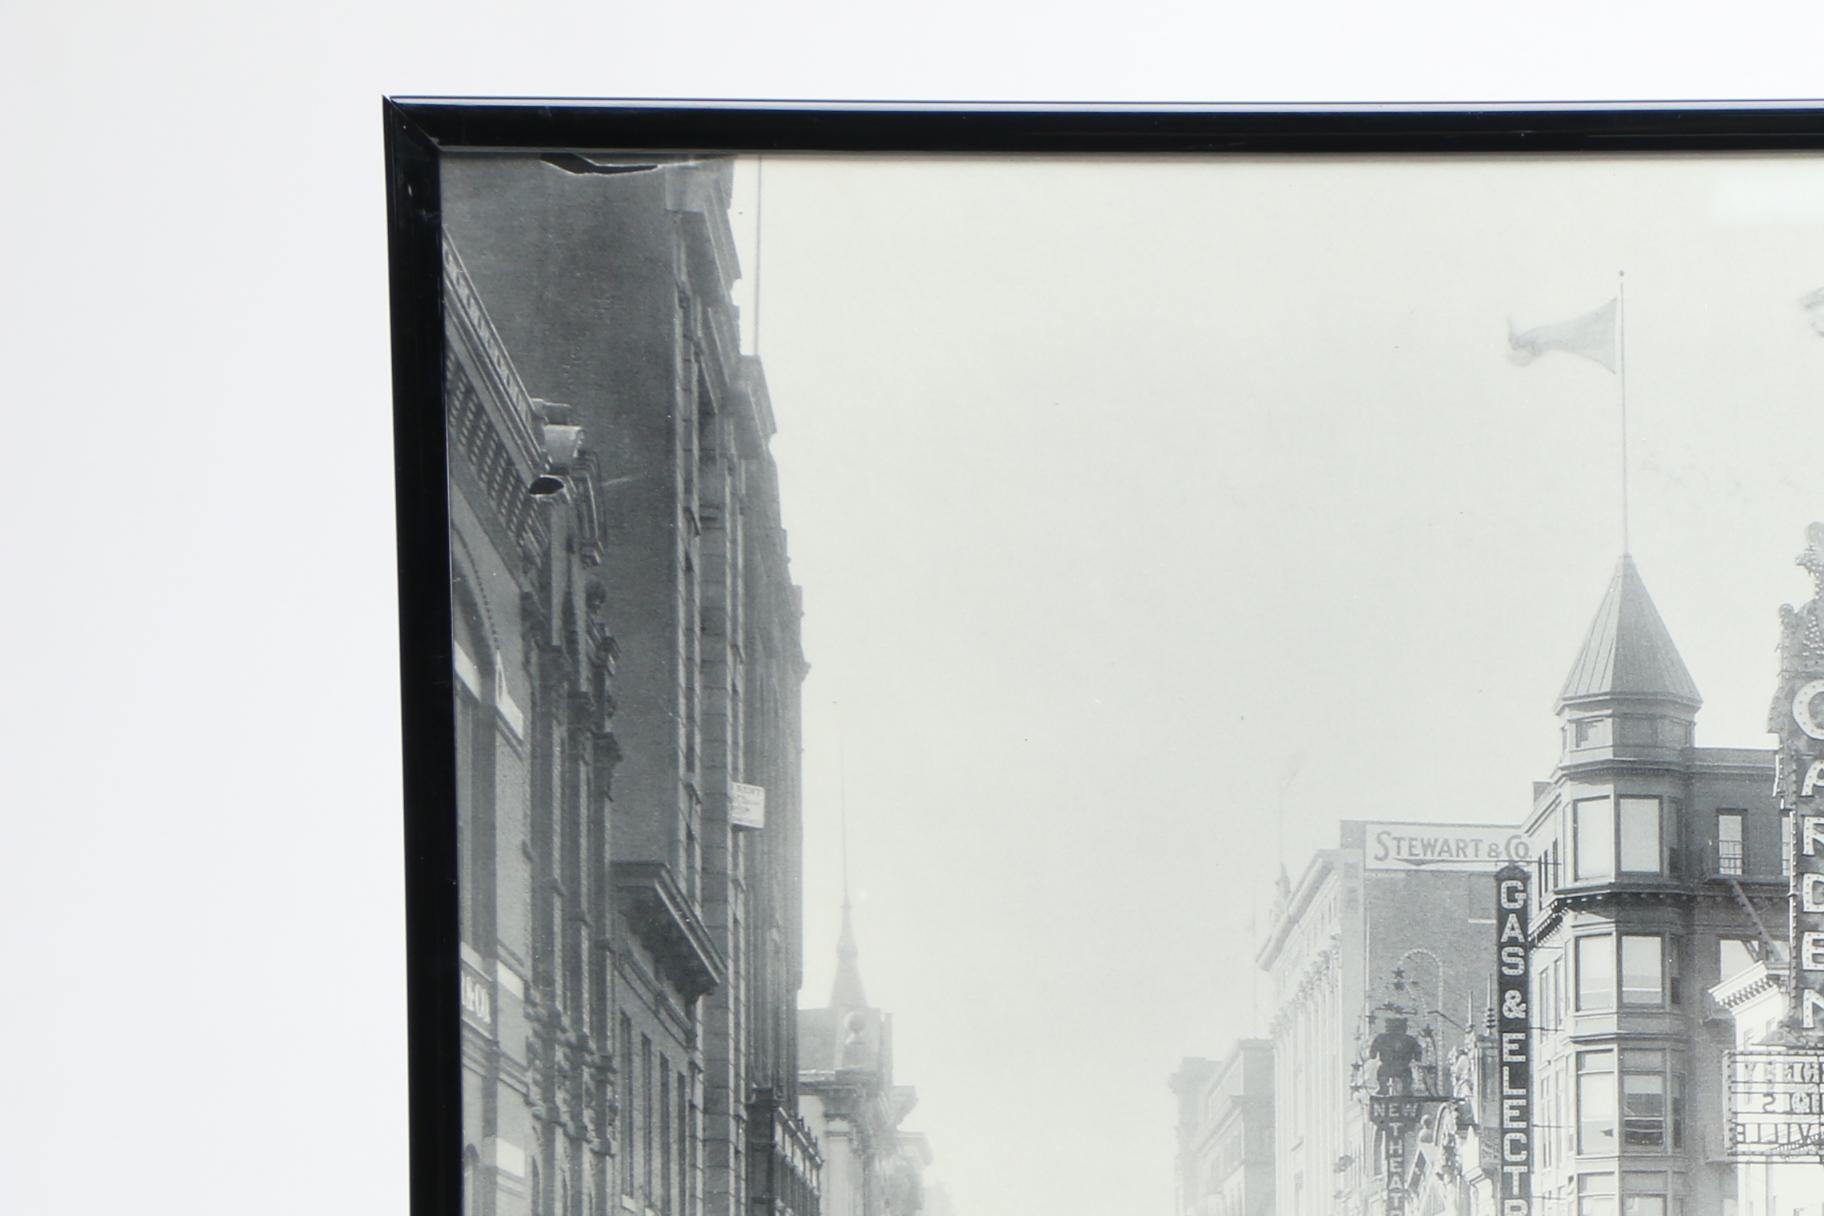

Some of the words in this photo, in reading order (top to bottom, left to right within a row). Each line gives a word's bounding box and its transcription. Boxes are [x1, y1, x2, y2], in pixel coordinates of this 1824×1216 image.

[1374, 831, 1483, 862] STEWART
[1487, 842, 1500, 859] &
[1500, 879, 1527, 976] GAS
[1502, 989, 1528, 1020] &
[1373, 1103, 1418, 1117] NEW
